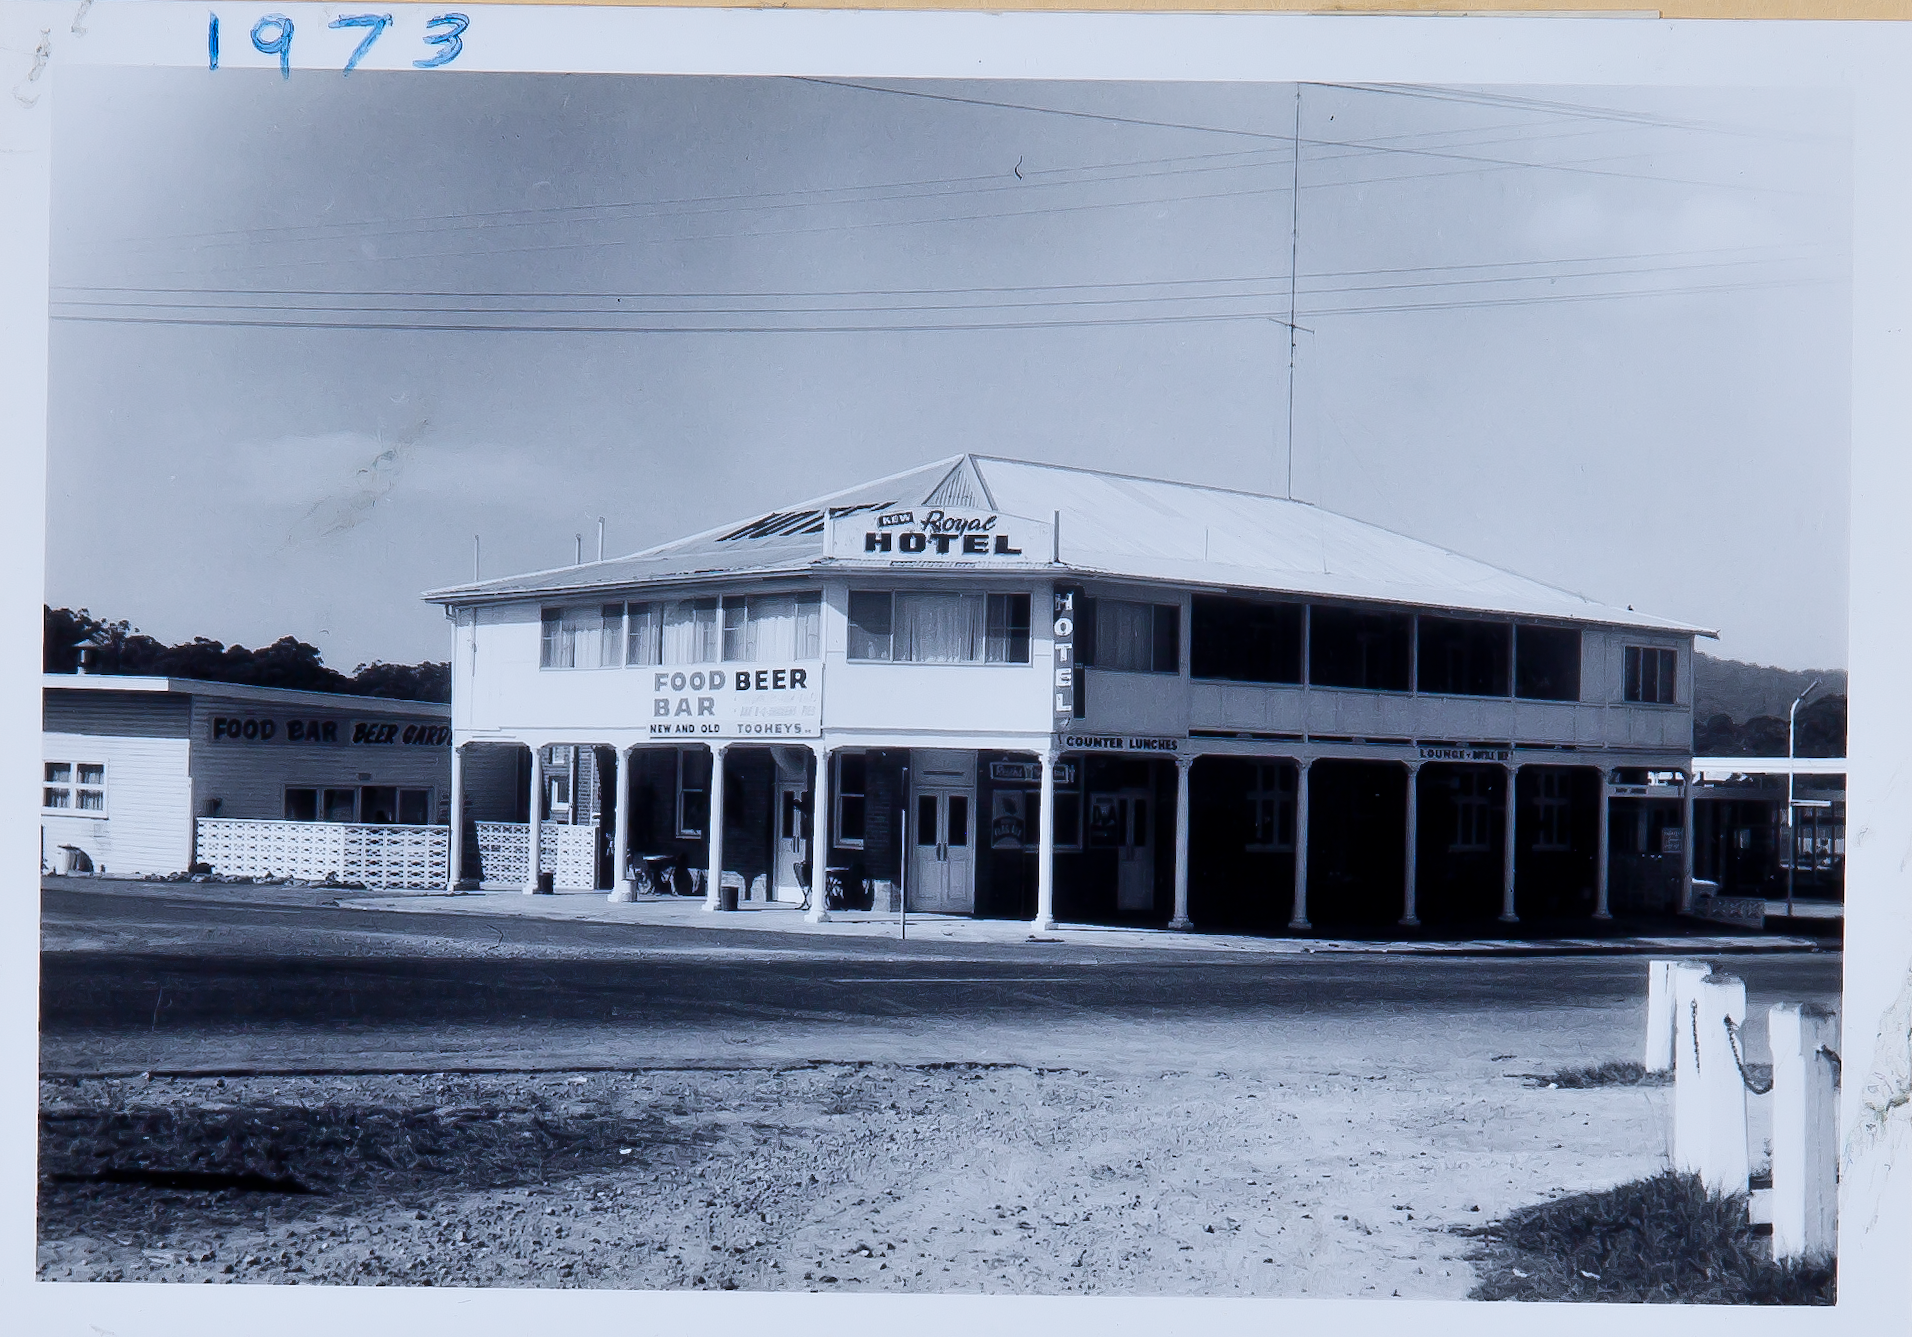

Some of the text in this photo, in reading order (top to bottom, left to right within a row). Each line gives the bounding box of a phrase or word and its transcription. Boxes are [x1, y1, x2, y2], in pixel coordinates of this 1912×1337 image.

[208, 11, 470, 80] 1973
[921, 510, 997, 536] Royal
[865, 531, 1022, 554] HOTEL
[1054, 592, 1074, 712] HOTEL
[654, 670, 726, 691] FOOD
[735, 668, 807, 691] BEER
[653, 696, 715, 717] BAR
[212, 717, 338, 742] FOOD BAR
[352, 722, 399, 744] BEER
[650, 723, 802, 734] NEW AND OLD TOOHEYS
[1066, 736, 1178, 750] COUNTER LUNCHES
[1419, 748, 1465, 759] LOUNGE
